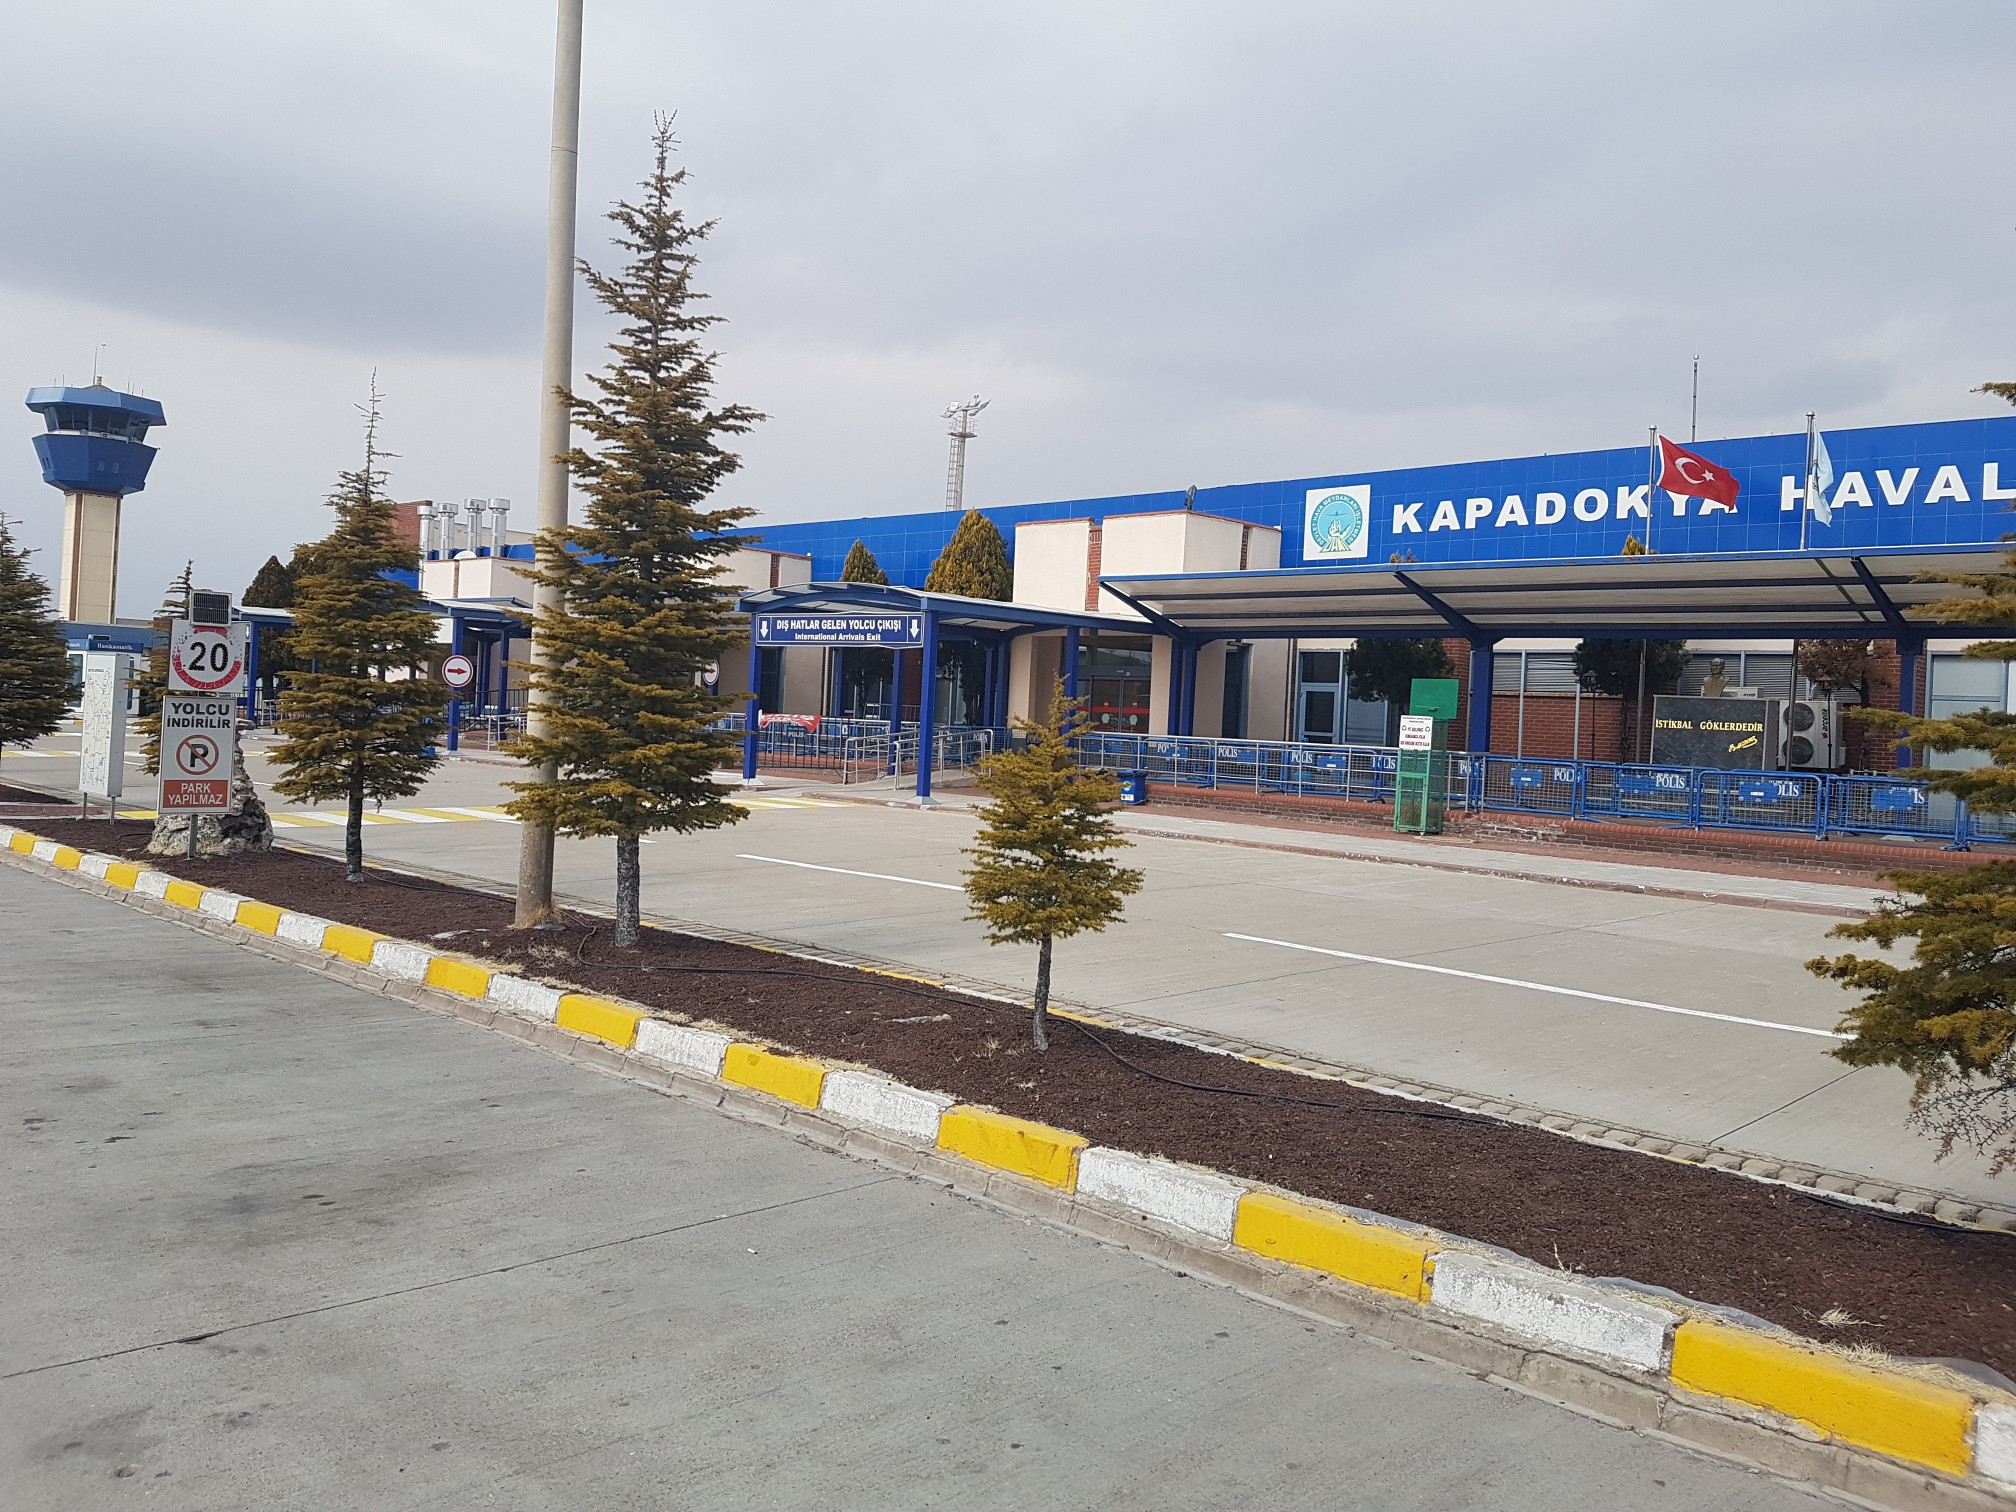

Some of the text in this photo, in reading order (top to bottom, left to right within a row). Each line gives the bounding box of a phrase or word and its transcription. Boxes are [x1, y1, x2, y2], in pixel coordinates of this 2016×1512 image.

[1781, 462, 2016, 511] HAVAL
[777, 620, 901, 632] DIŞ HATLAR GELEN YOLCU ÇIKIŞI
[188, 642, 229, 672] 20
[171, 702, 230, 716] YOLCU
[167, 715, 231, 729] İNDİRİLİR
[1655, 718, 1763, 731] İSTİKBAL GÖKLERDEDİR
[181, 783, 211, 794] PARK
[168, 794, 223, 805] YAPILMAZ
